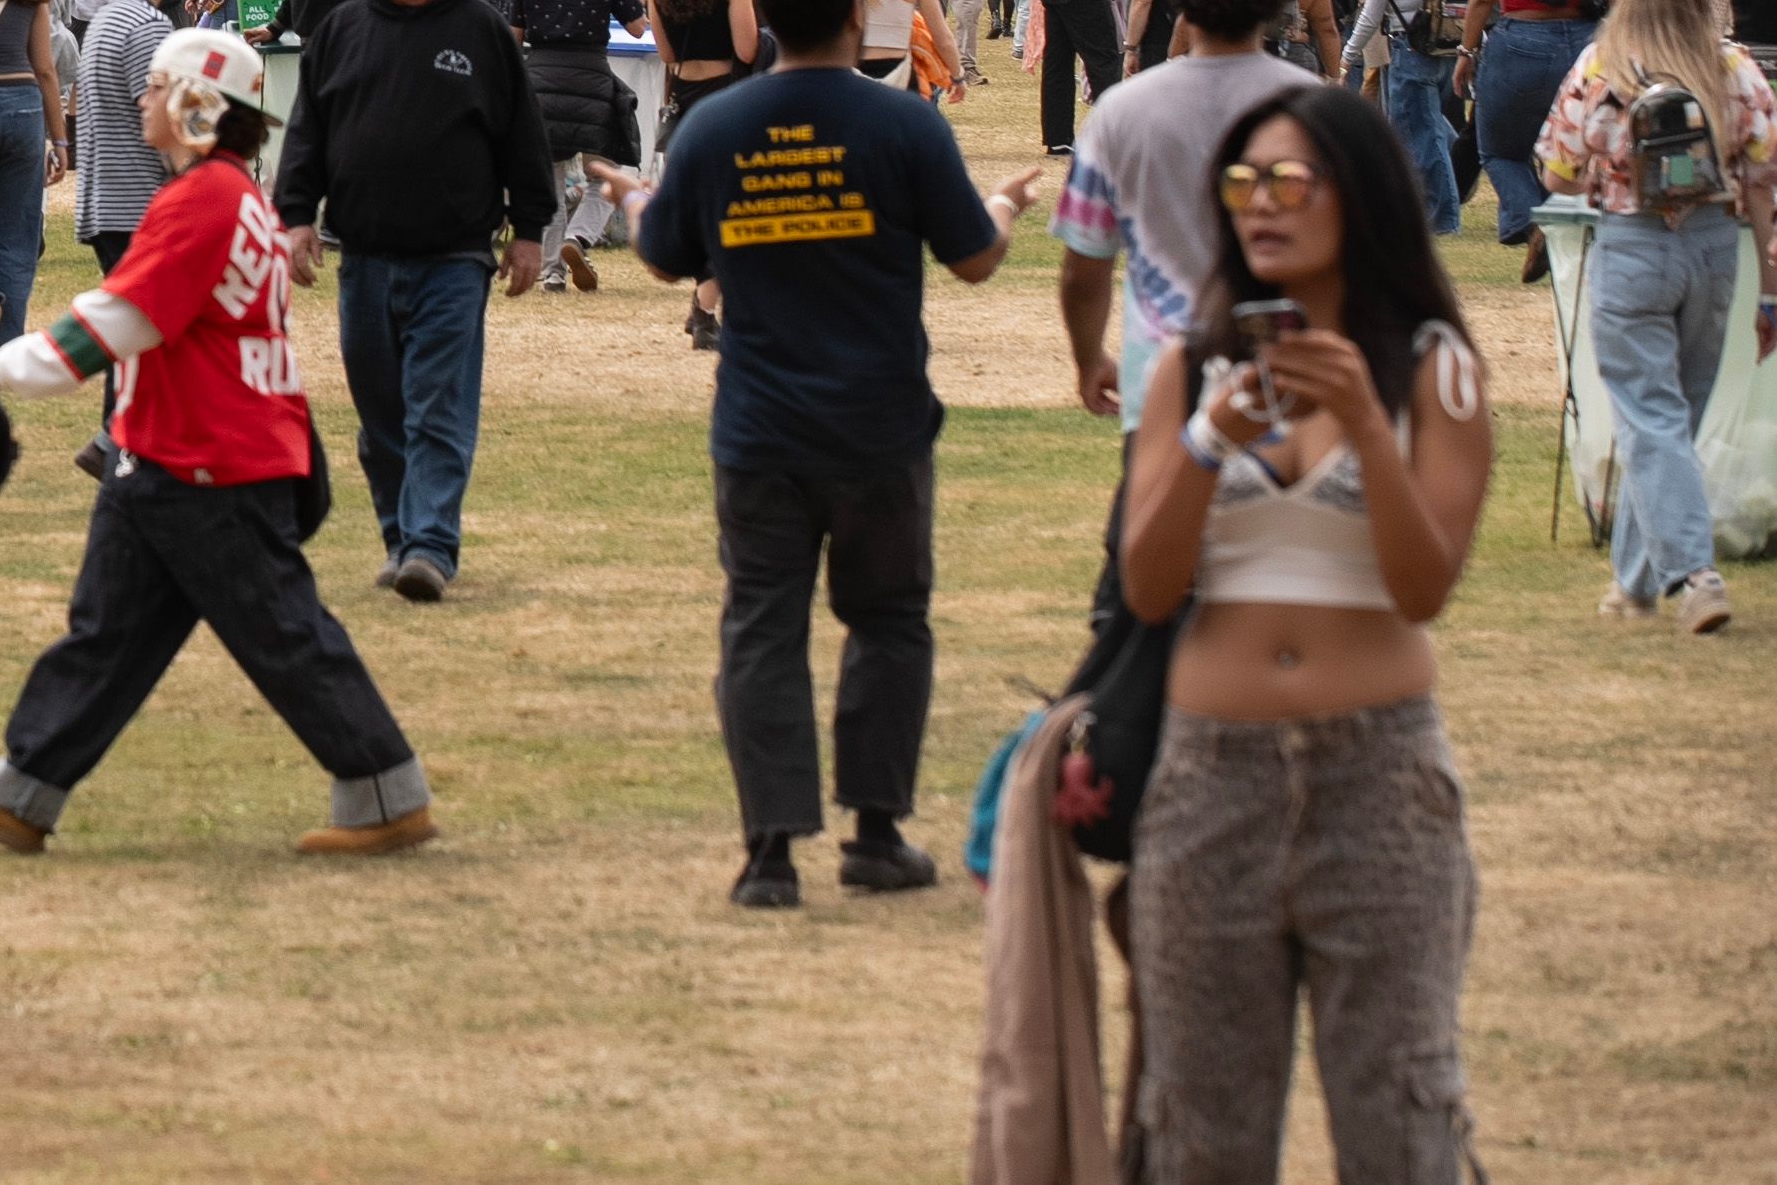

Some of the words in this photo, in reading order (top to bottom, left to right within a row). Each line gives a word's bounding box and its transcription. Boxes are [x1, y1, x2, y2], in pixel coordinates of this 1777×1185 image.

[245, 13, 269, 21] FOOD
[766, 125, 815, 143] THE
[734, 146, 847, 169] LARGEST
[741, 171, 813, 193] GANG
[817, 169, 844, 188] IN
[727, 194, 834, 217] AMERICA
[839, 192, 865, 209] IS
[733, 221, 775, 238] THE
[782, 217, 864, 234] POLICE
